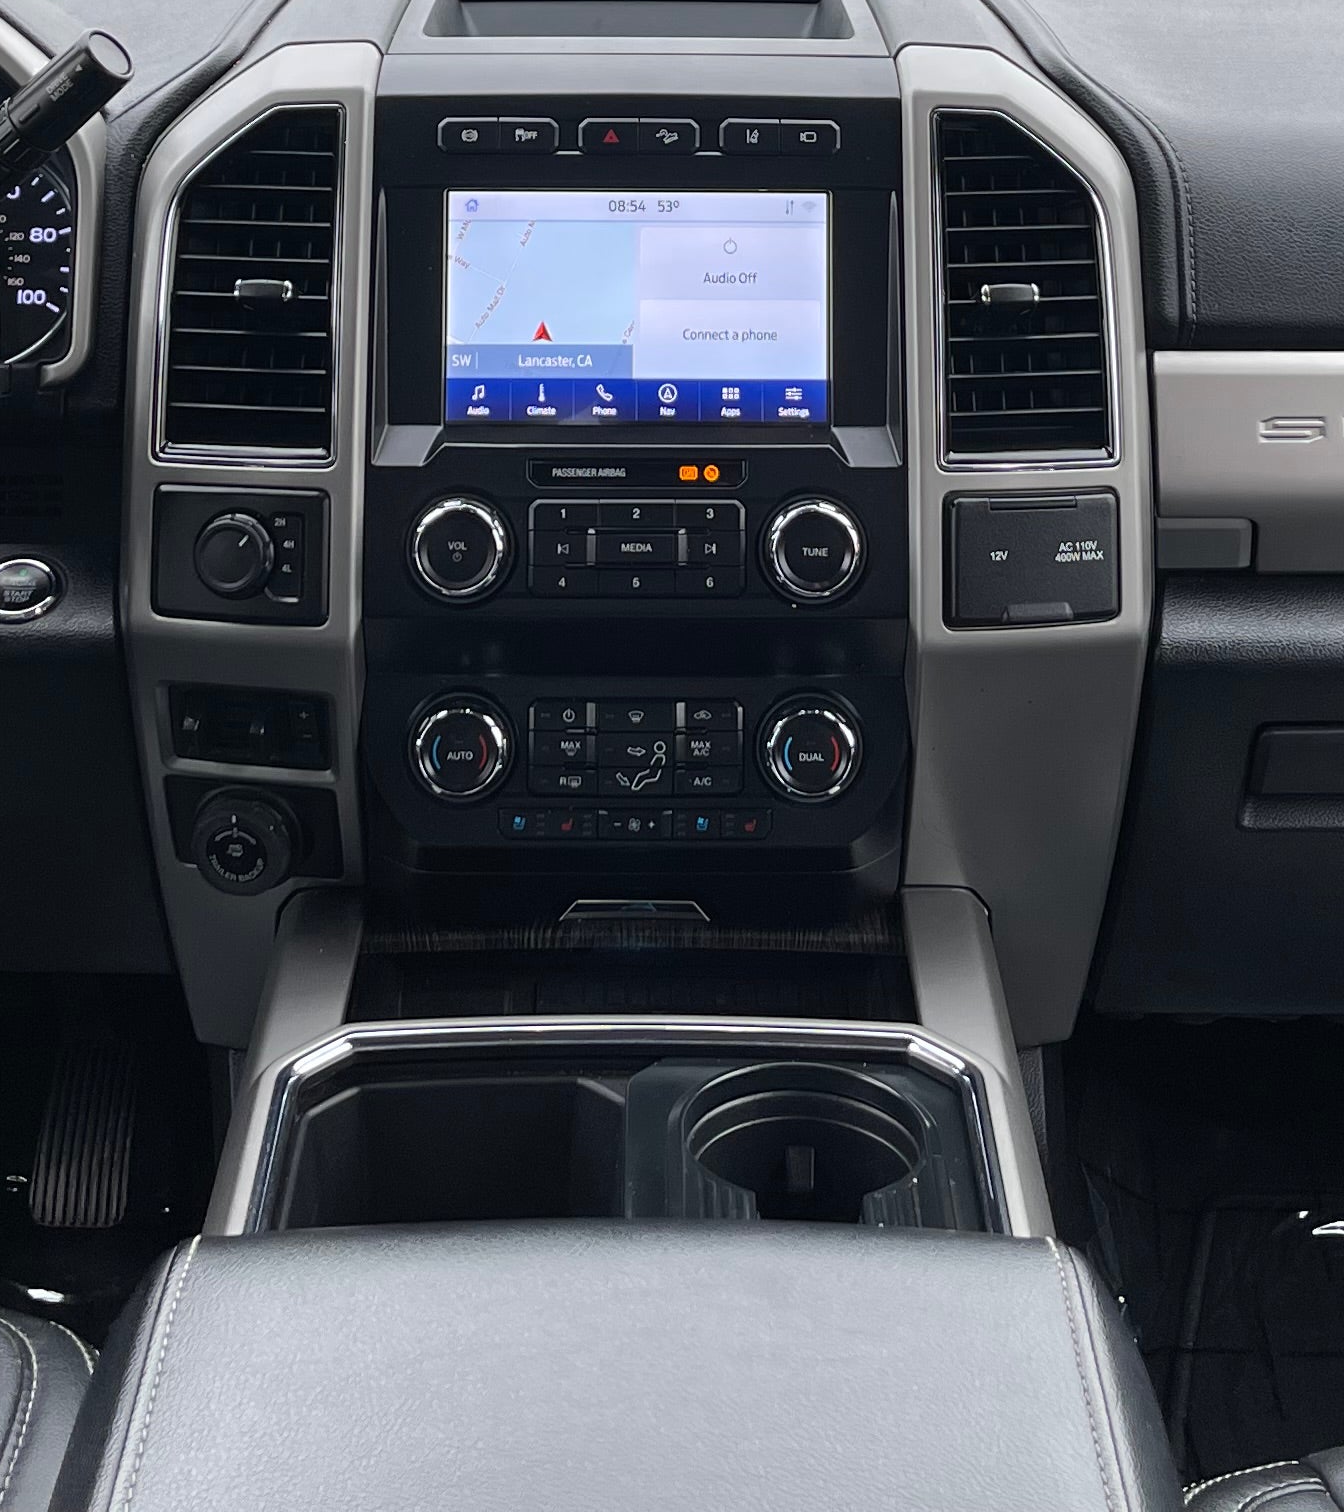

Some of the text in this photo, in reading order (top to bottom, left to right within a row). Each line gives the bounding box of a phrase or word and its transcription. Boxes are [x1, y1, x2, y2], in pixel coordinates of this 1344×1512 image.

[50, 78, 75, 102] MODE
[608, 199, 646, 213] 08:54
[9, 232, 24, 241] 120
[29, 227, 56, 243] 80
[14, 254, 30, 263] 140
[8, 277, 24, 286] 160
[703, 271, 758, 284] Audio Off
[16, 289, 46, 305] 100
[475, 311, 490, 329] Auto
[682, 328, 778, 343] Connect a phone
[452, 354, 472, 367] SW
[518, 354, 593, 368] Lancaster, CA
[467, 405, 490, 416] Audio
[526, 405, 556, 416] Climate
[592, 405, 617, 416] Phone
[659, 406, 676, 417] Nav
[720, 406, 741, 419] Apps
[778, 406, 810, 419] Settings
[552, 467, 626, 478] PASSENGER AIRBAG
[560, 508, 566, 519] 1
[632, 508, 640, 519] 2
[706, 508, 714, 519] 3
[274, 517, 286, 527] 2H
[283, 540, 295, 549] 4H
[447, 541, 467, 551] VOL
[621, 543, 653, 553] MEDIA
[1058, 540, 1098, 552] AC 110V
[802, 547, 829, 557] TUNE
[990, 550, 1009, 561] 12V
[1055, 550, 1104, 562] 400W MAX
[281, 564, 292, 573] 4L
[558, 577, 566, 587] 4
[632, 577, 640, 588] 5
[706, 577, 714, 588] 6
[561, 740, 581, 750] MAX
[691, 740, 711, 750] MAX
[447, 750, 474, 761] AUTO
[693, 748, 710, 757] A/C
[798, 752, 825, 762] DUAL
[693, 777, 712, 786] A/C
